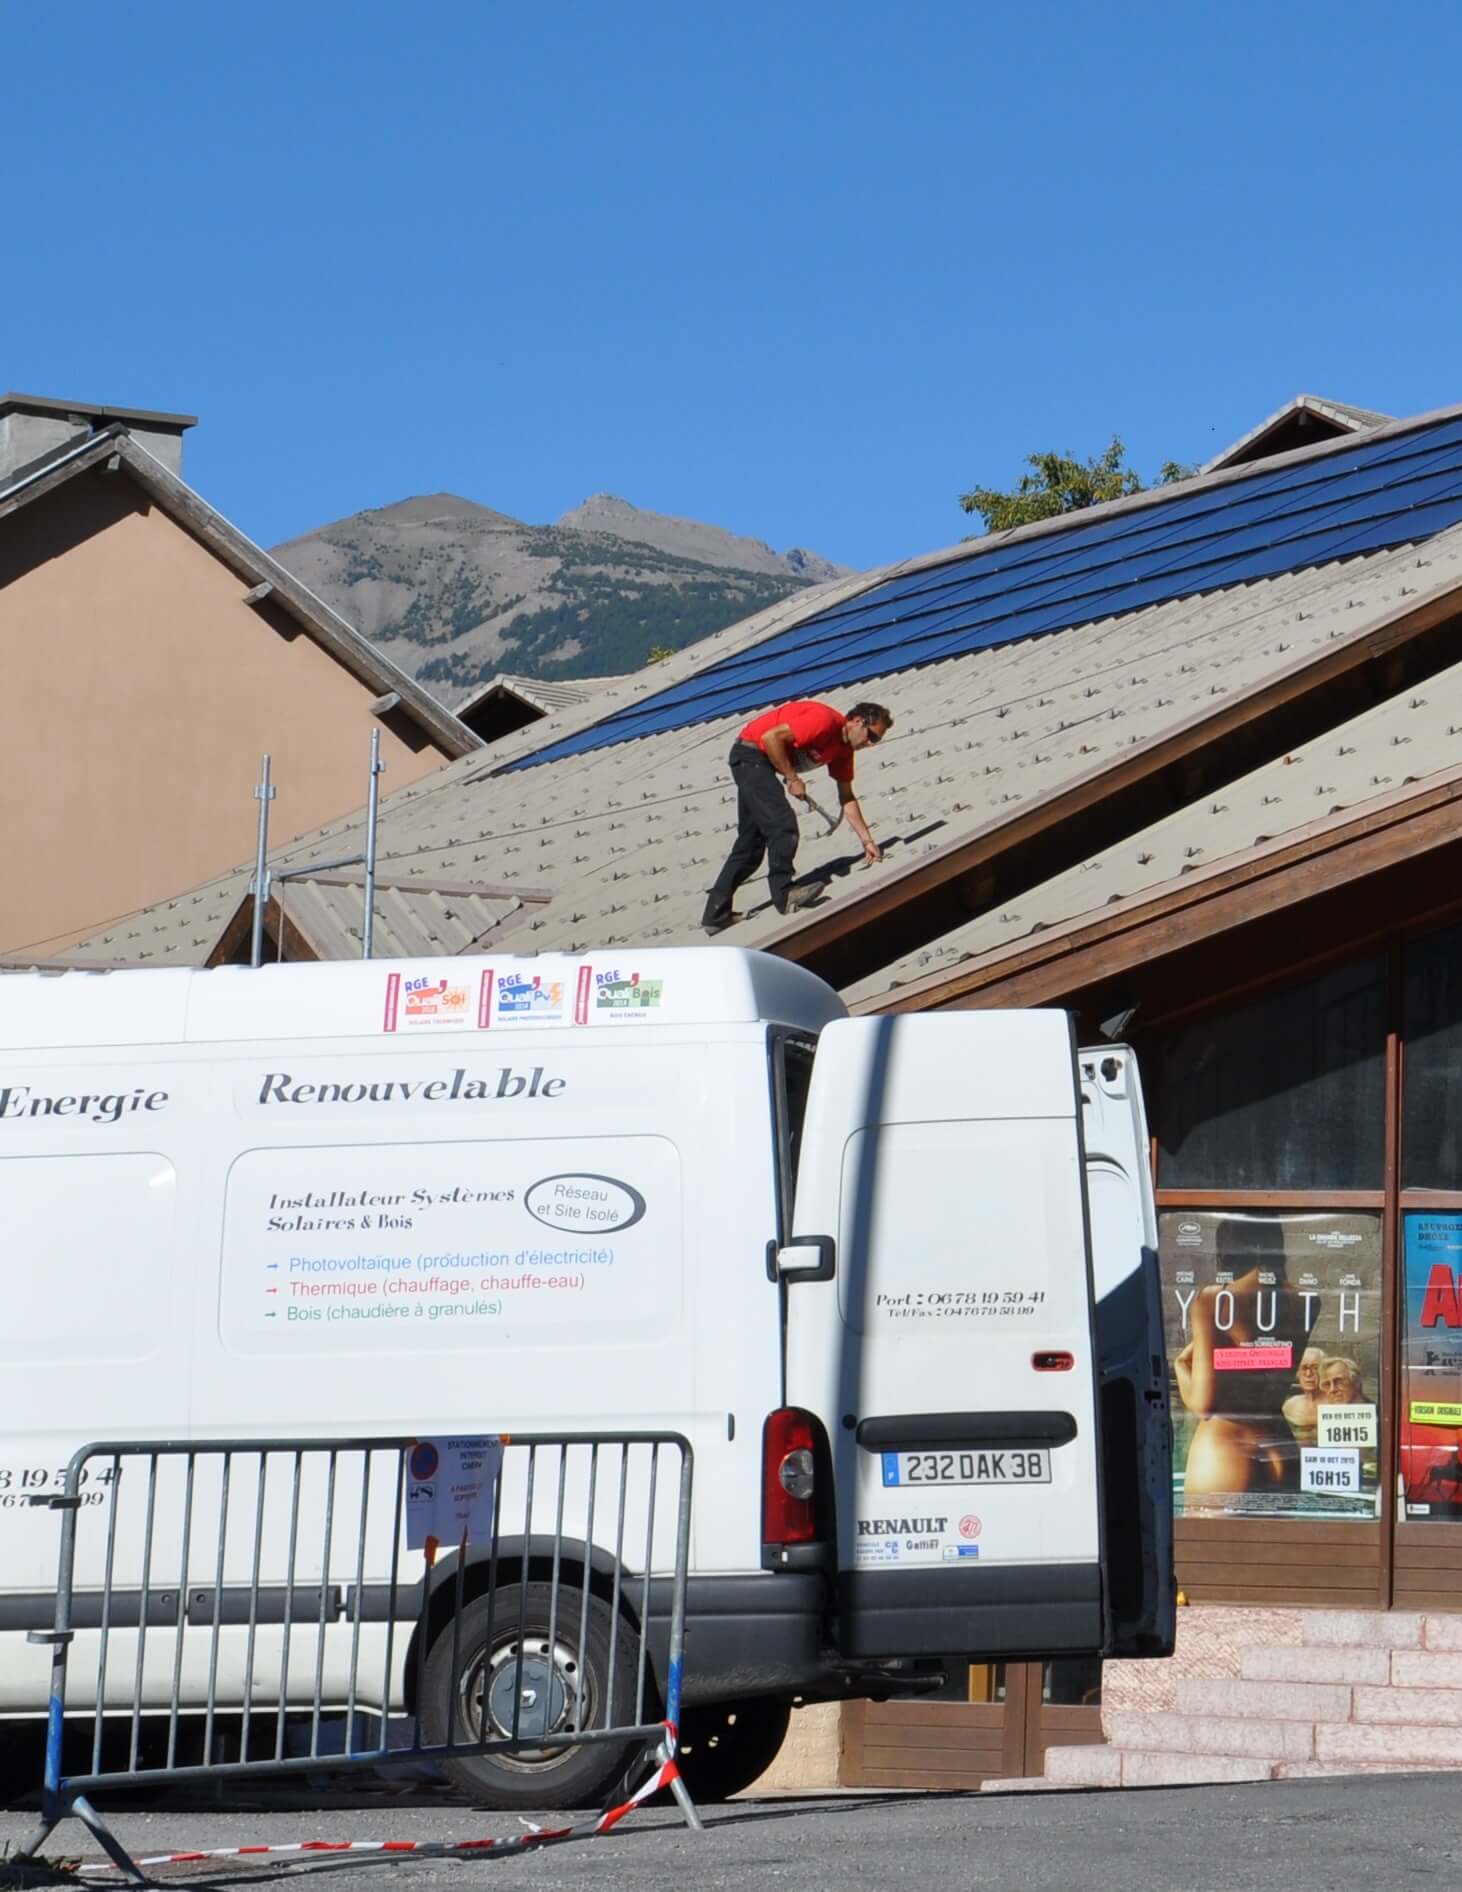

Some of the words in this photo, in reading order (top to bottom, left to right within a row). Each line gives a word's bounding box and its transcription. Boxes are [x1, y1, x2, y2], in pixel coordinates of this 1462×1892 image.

[405, 977, 429, 992] RGE
[497, 973, 522, 988] RGE
[596, 970, 621, 985] RGE
[0, 1086, 168, 1123] Energie
[257, 1066, 567, 1107] Renouvelable
[268, 1190, 406, 1210] Installateur
[410, 1186, 516, 1211] Systèmes
[553, 1184, 609, 1202] Réseau
[536, 1204, 551, 1217] et
[554, 1203, 581, 1219] Site
[585, 1207, 620, 1223] Isolé
[266, 1214, 356, 1232] Solaires
[360, 1215, 373, 1230] &
[378, 1214, 413, 1231] Bois
[289, 1254, 412, 1274] Photovoltaïque
[417, 1251, 510, 1273] (production
[514, 1247, 615, 1267] d'électricité)
[289, 1279, 377, 1298] Thermique
[383, 1276, 474, 1297] (chauffage,
[480, 1273, 585, 1292] chauffe-eau)
[876, 1293, 912, 1306] Port
[927, 1292, 951, 1306] 06
[955, 1292, 977, 1305] 78
[982, 1291, 999, 1304] 19
[1003, 1291, 1024, 1304] 59
[1028, 1291, 1046, 1304] 41
[287, 1305, 322, 1321] Bois
[327, 1303, 410, 1322] (chaudière
[414, 1303, 424, 1318] à
[428, 1300, 503, 1321] granulés)
[1175, 1290, 1360, 1333] YOUTH
[1326, 1426, 1368, 1442] 18H15
[907, 1455, 954, 1481] 232
[960, 1453, 1007, 1480] DAK
[1012, 1452, 1043, 1478] 38
[22, 1468, 48, 1488] 19
[1309, 1470, 1351, 1486] 16H15
[857, 1517, 948, 1536] RENAULT
